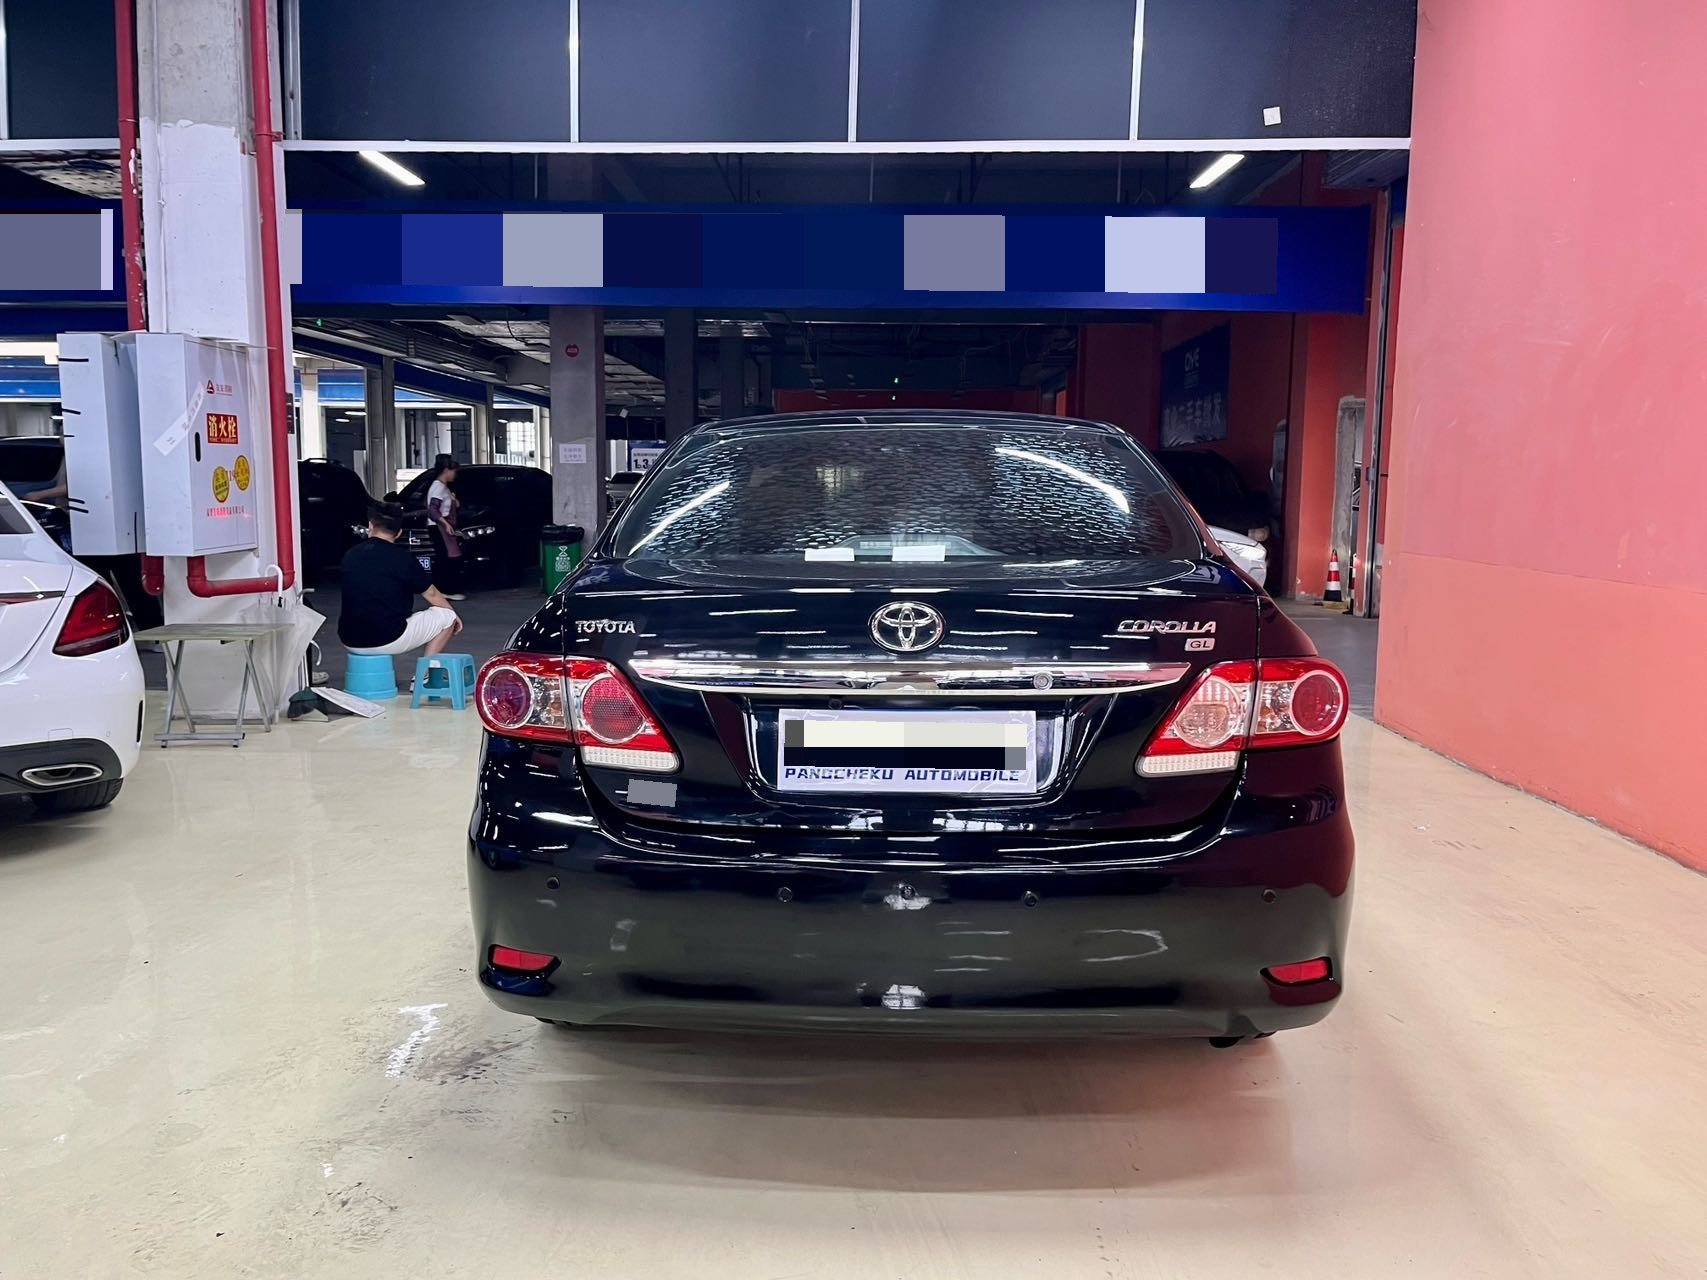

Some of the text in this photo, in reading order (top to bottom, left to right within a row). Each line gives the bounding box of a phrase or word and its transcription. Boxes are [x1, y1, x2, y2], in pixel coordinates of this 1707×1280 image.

[208, 415, 237, 438] 消火栓
[575, 619, 636, 633] TOYOTA
[1117, 620, 1216, 634] COROLLA
[1190, 640, 1211, 649] GL
[904, 769, 1020, 781] AUTOMOBILE
